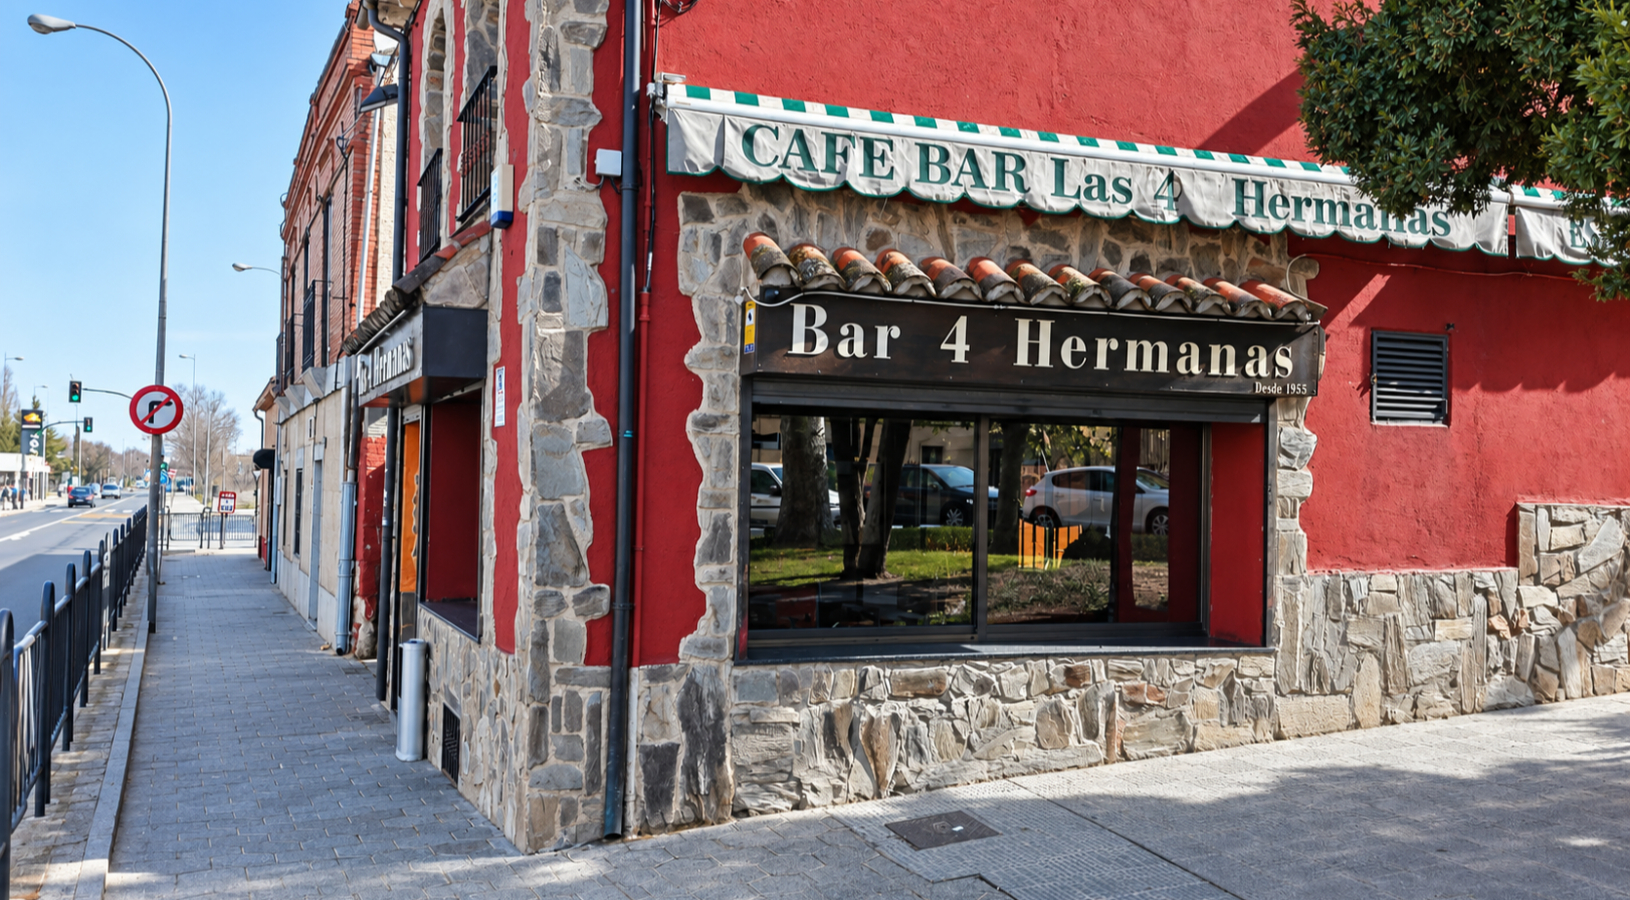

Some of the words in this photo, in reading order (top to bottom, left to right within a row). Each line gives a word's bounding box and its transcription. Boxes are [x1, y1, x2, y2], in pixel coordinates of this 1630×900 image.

[742, 124, 895, 181] CAFE
[915, 142, 1031, 194] BAR
[1050, 157, 1133, 205] Las
[1154, 170, 1178, 211] 4
[787, 302, 901, 360] Bar
[940, 315, 971, 364] 4
[1013, 317, 1294, 378] Hermanas
[1254, 381, 1283, 394] Desde
[1286, 382, 1308, 395] 1955
